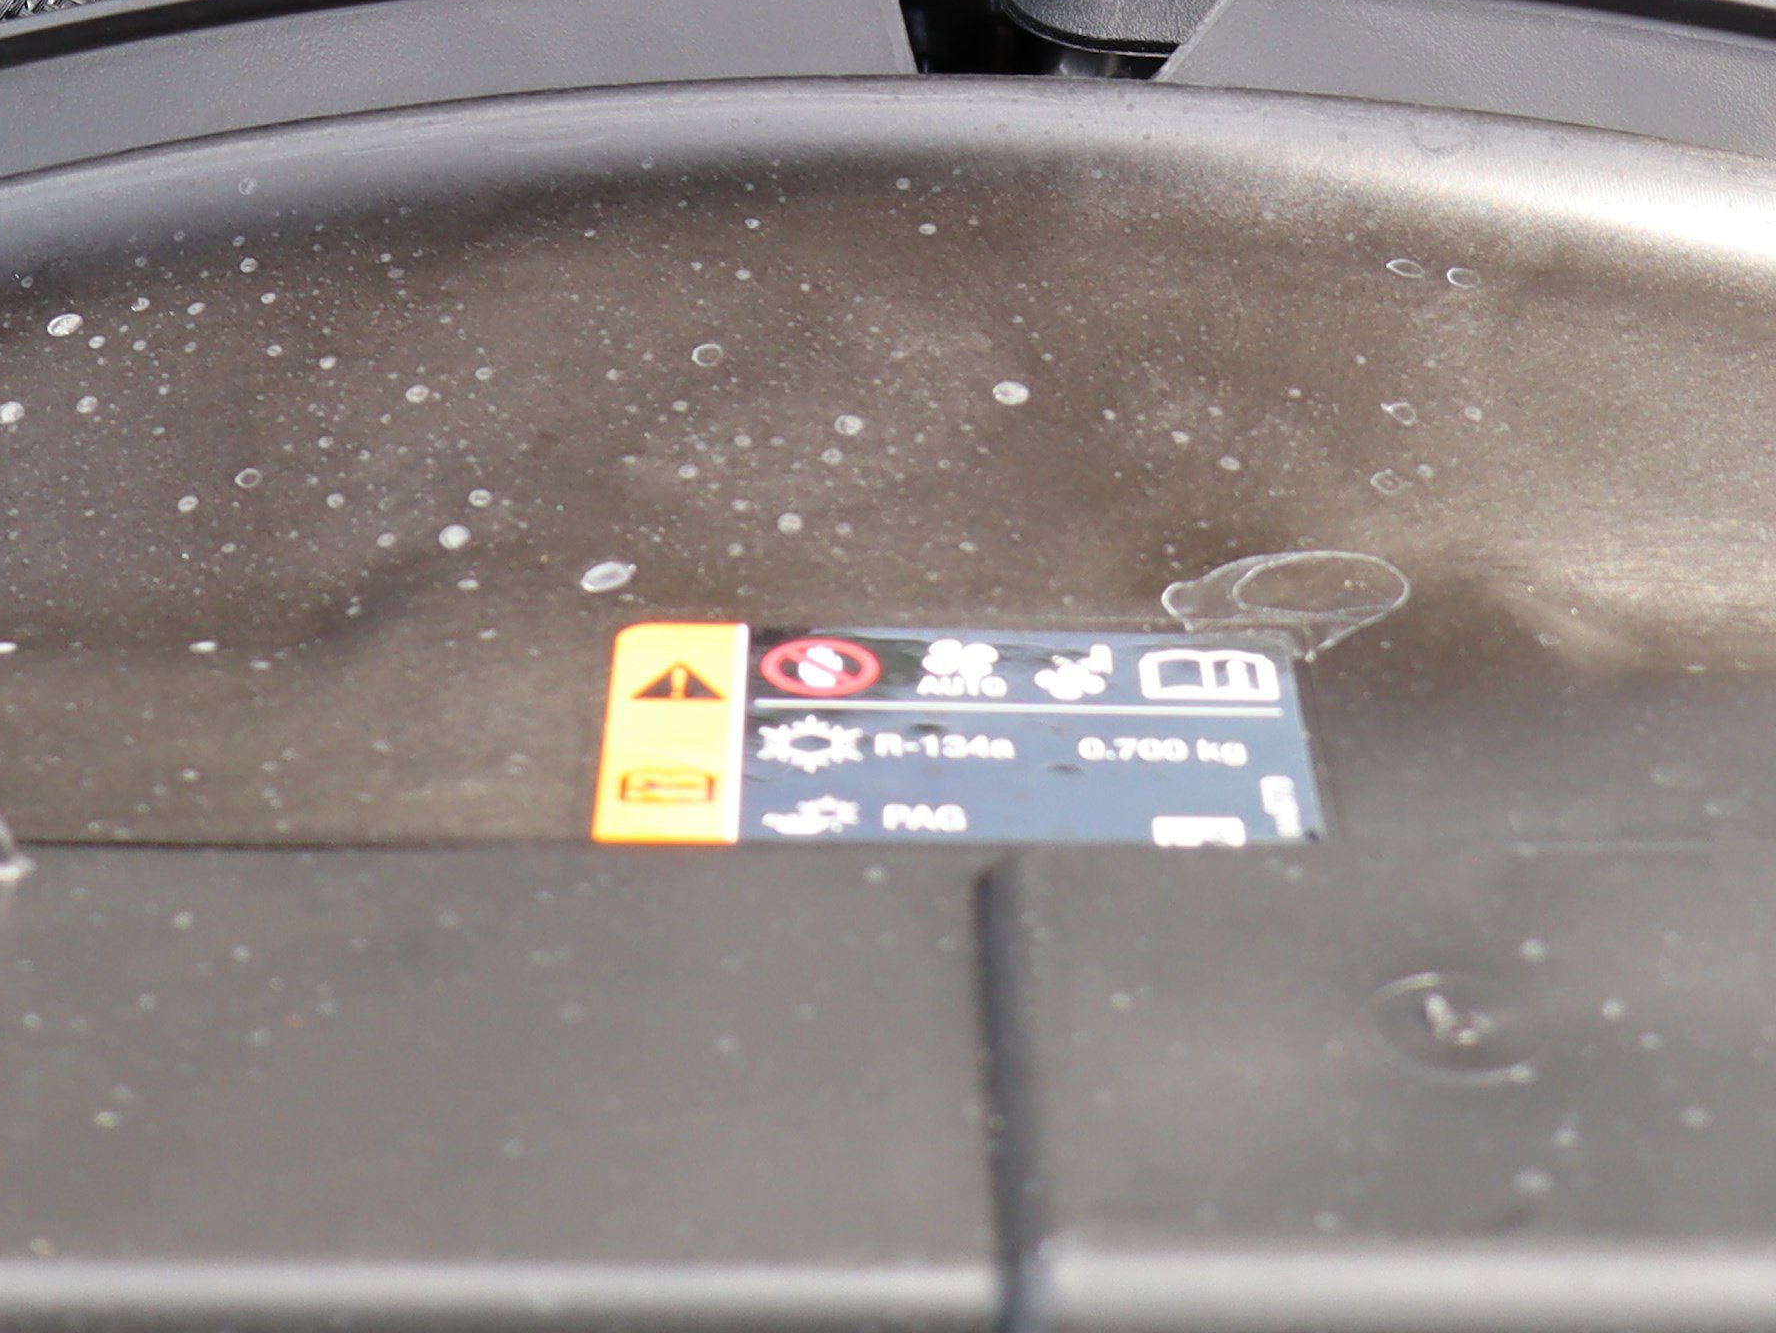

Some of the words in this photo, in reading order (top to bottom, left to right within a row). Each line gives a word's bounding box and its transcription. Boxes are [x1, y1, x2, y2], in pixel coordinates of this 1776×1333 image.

[916, 675, 1007, 697] AUTO
[874, 733, 1016, 760] R-134a
[1197, 737, 1248, 766] kg
[882, 804, 967, 832] PAG
